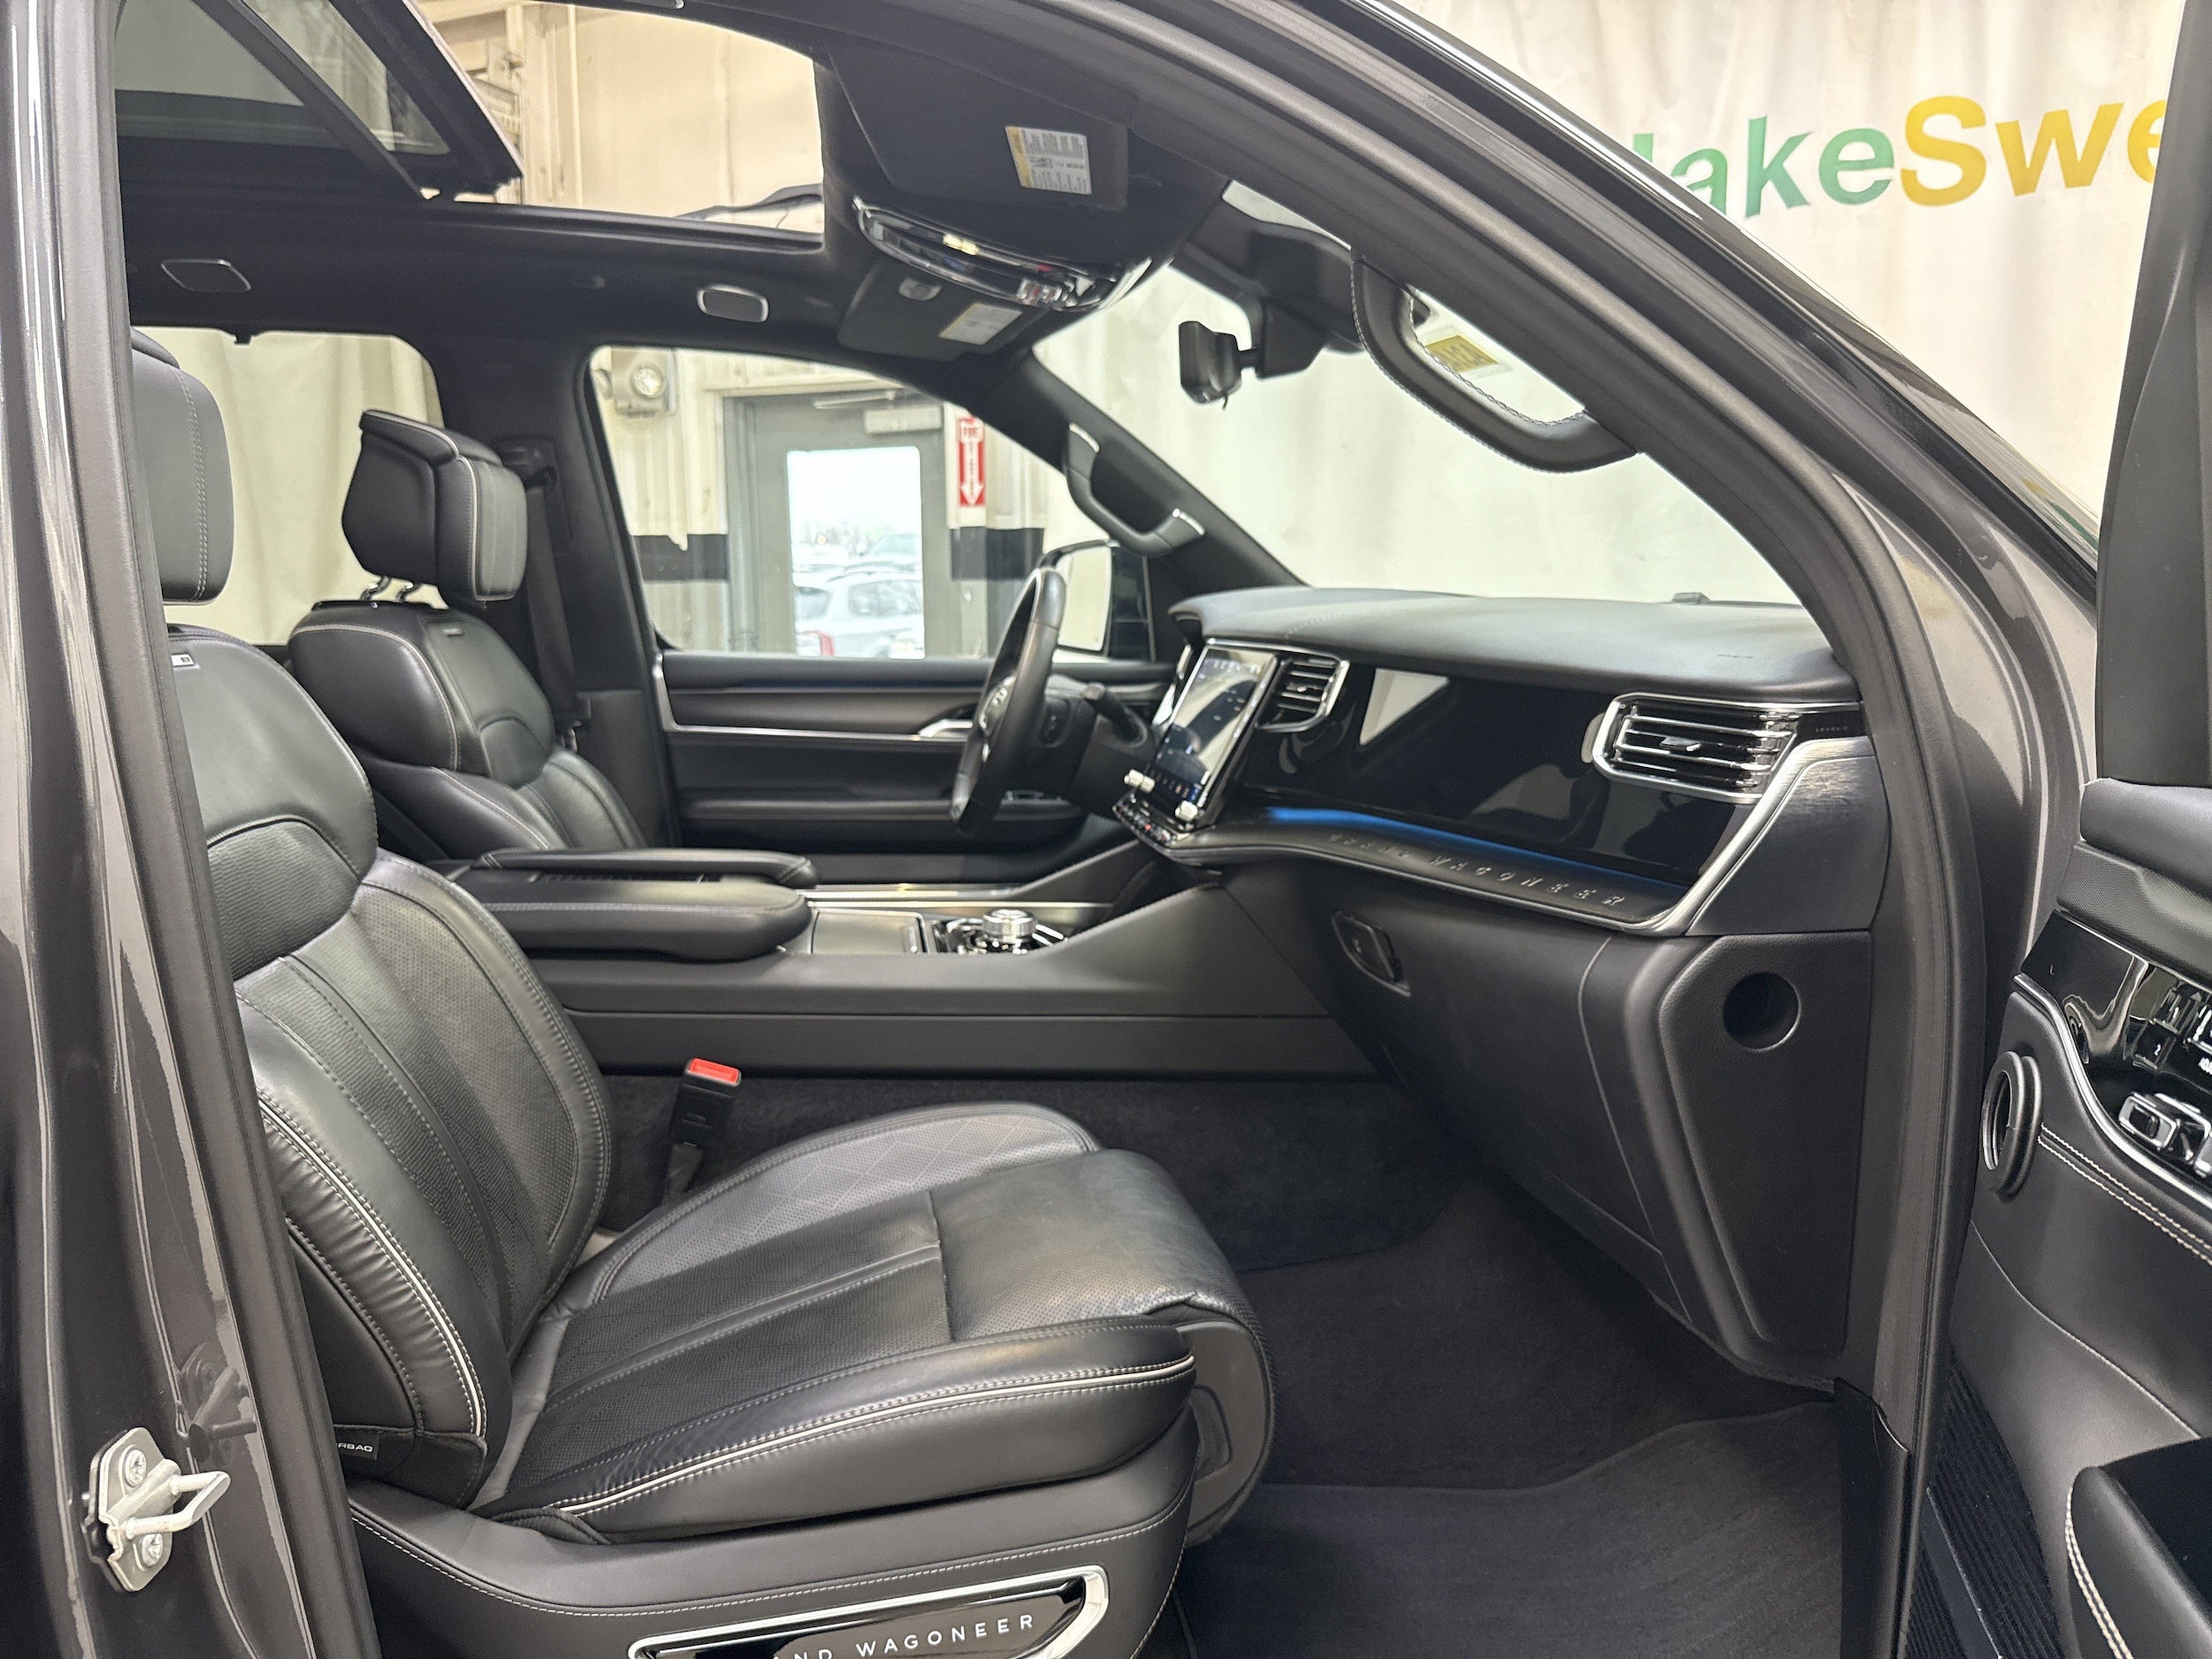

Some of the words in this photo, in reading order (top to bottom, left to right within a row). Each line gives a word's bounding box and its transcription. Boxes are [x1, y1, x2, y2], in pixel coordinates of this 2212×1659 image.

[1633, 95, 2167, 219] akeSwe
[1429, 856, 1624, 906] WAGONEER
[336, 1442, 373, 1453] RBAG
[856, 1613, 1033, 1657] WAGONEER
